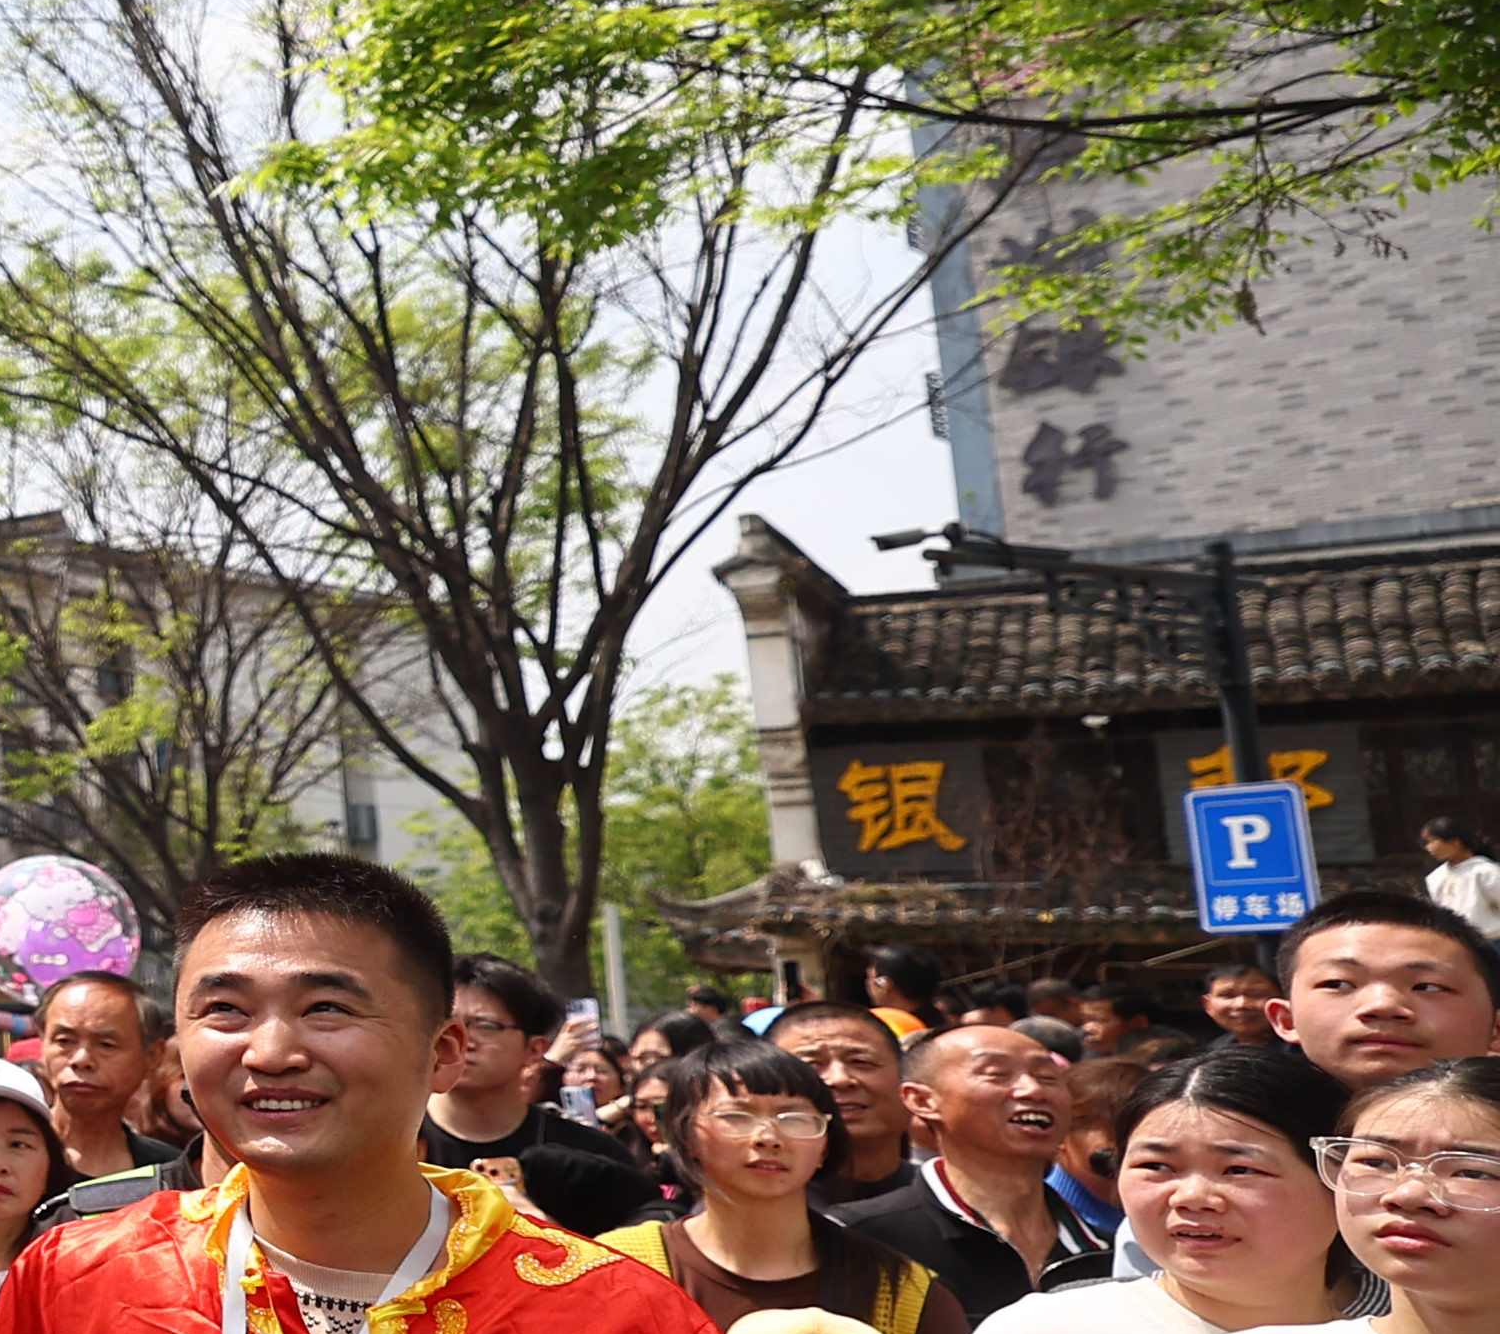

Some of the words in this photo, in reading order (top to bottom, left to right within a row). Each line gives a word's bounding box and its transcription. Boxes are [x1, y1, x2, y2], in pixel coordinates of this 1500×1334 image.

[1220, 814, 1271, 868] P
[1211, 891, 1306, 922] 停车场
